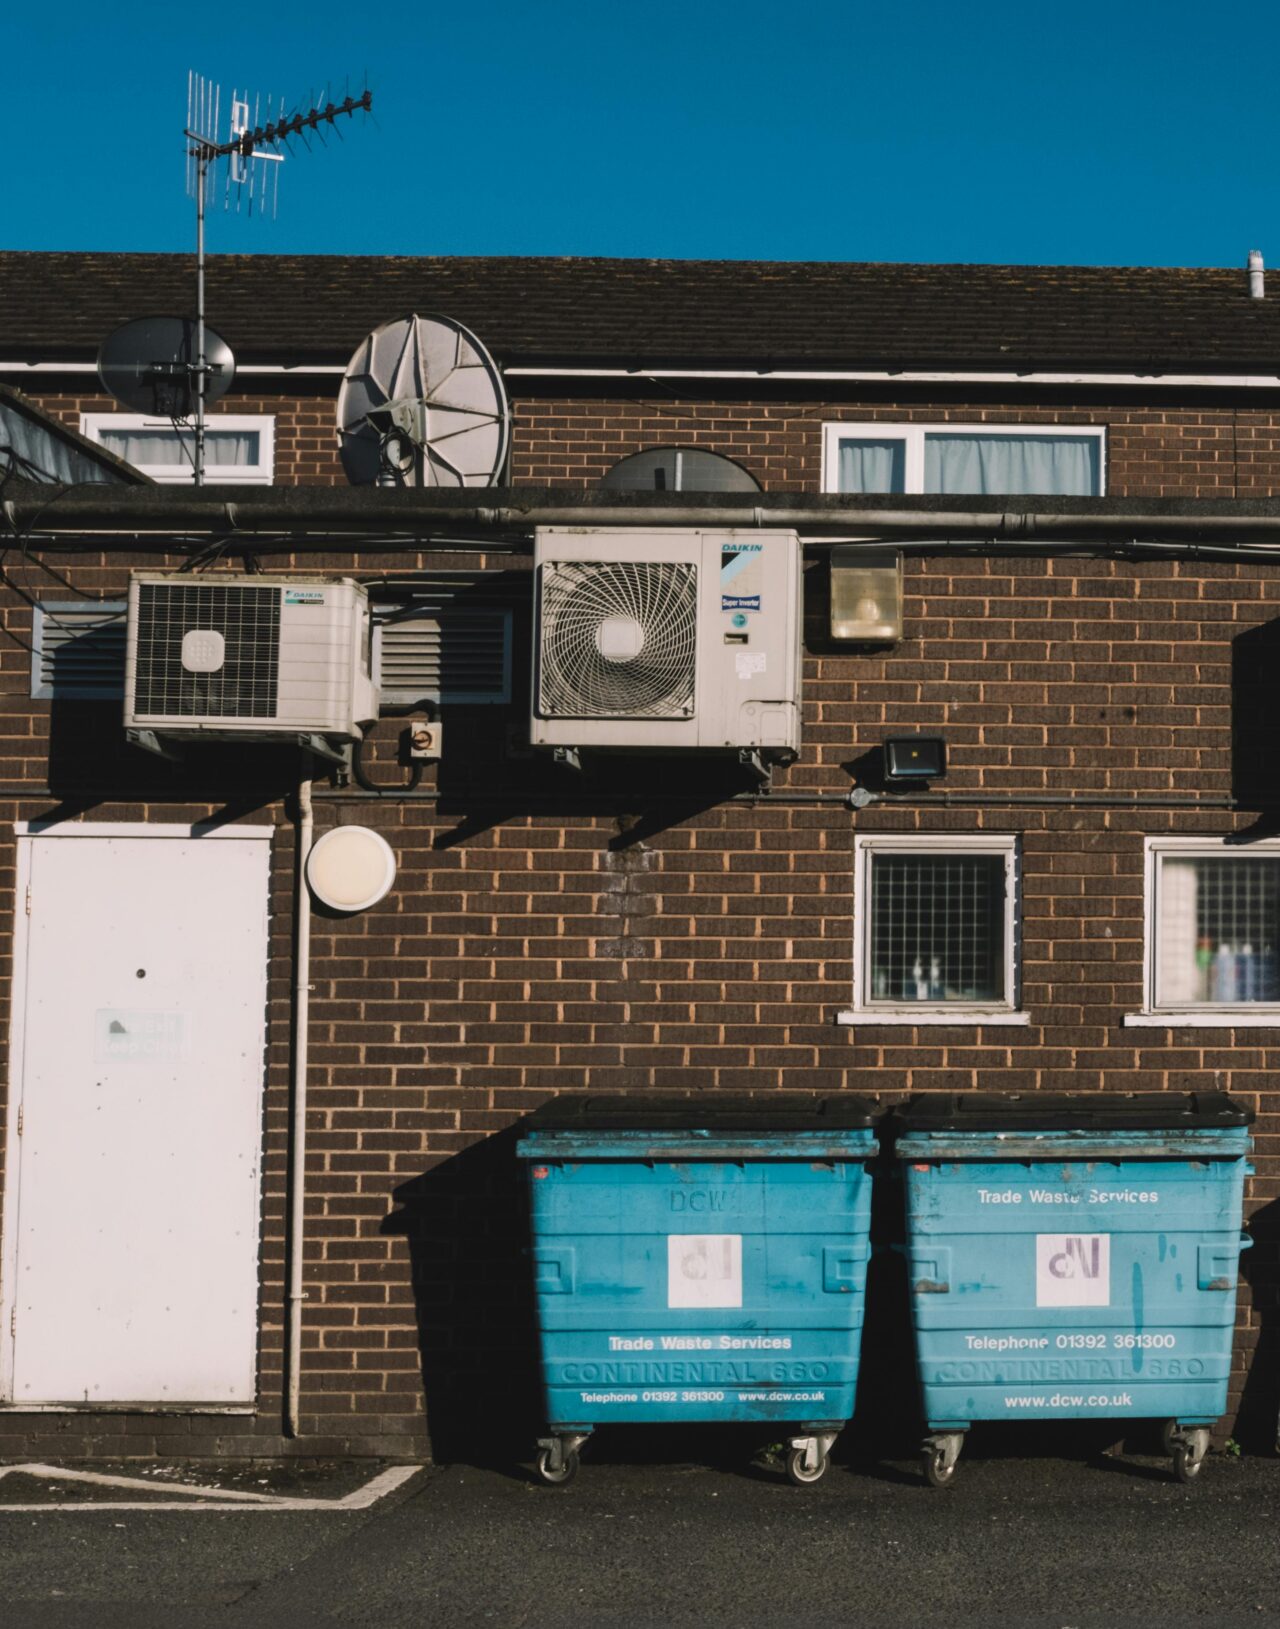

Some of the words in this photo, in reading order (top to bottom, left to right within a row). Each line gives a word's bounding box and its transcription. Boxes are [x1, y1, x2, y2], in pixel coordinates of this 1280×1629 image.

[722, 544, 762, 552] DAIKIN
[669, 1189, 728, 1213] DCW
[977, 1189, 1022, 1204] Trade
[1029, 1190, 1079, 1204] Waste
[1089, 1189, 1159, 1204] Services
[609, 1336, 655, 1350] Trade
[660, 1336, 712, 1350] Waste
[719, 1335, 792, 1349] Services
[965, 1335, 1049, 1351] Telephone
[1056, 1334, 1107, 1349] 01392
[1113, 1334, 1176, 1348] 361300
[560, 1360, 757, 1384] CONTINENTAL
[769, 1360, 830, 1382] 660
[938, 1358, 1134, 1381] CONTINENTAL
[1147, 1357, 1206, 1377] 660
[580, 1392, 638, 1404] Telephone
[642, 1392, 677, 1402] 01392
[681, 1391, 724, 1402] 361300
[738, 1391, 825, 1402] www.dcw.co.uk
[1004, 1391, 1133, 1408] www.dcw.co.uk
